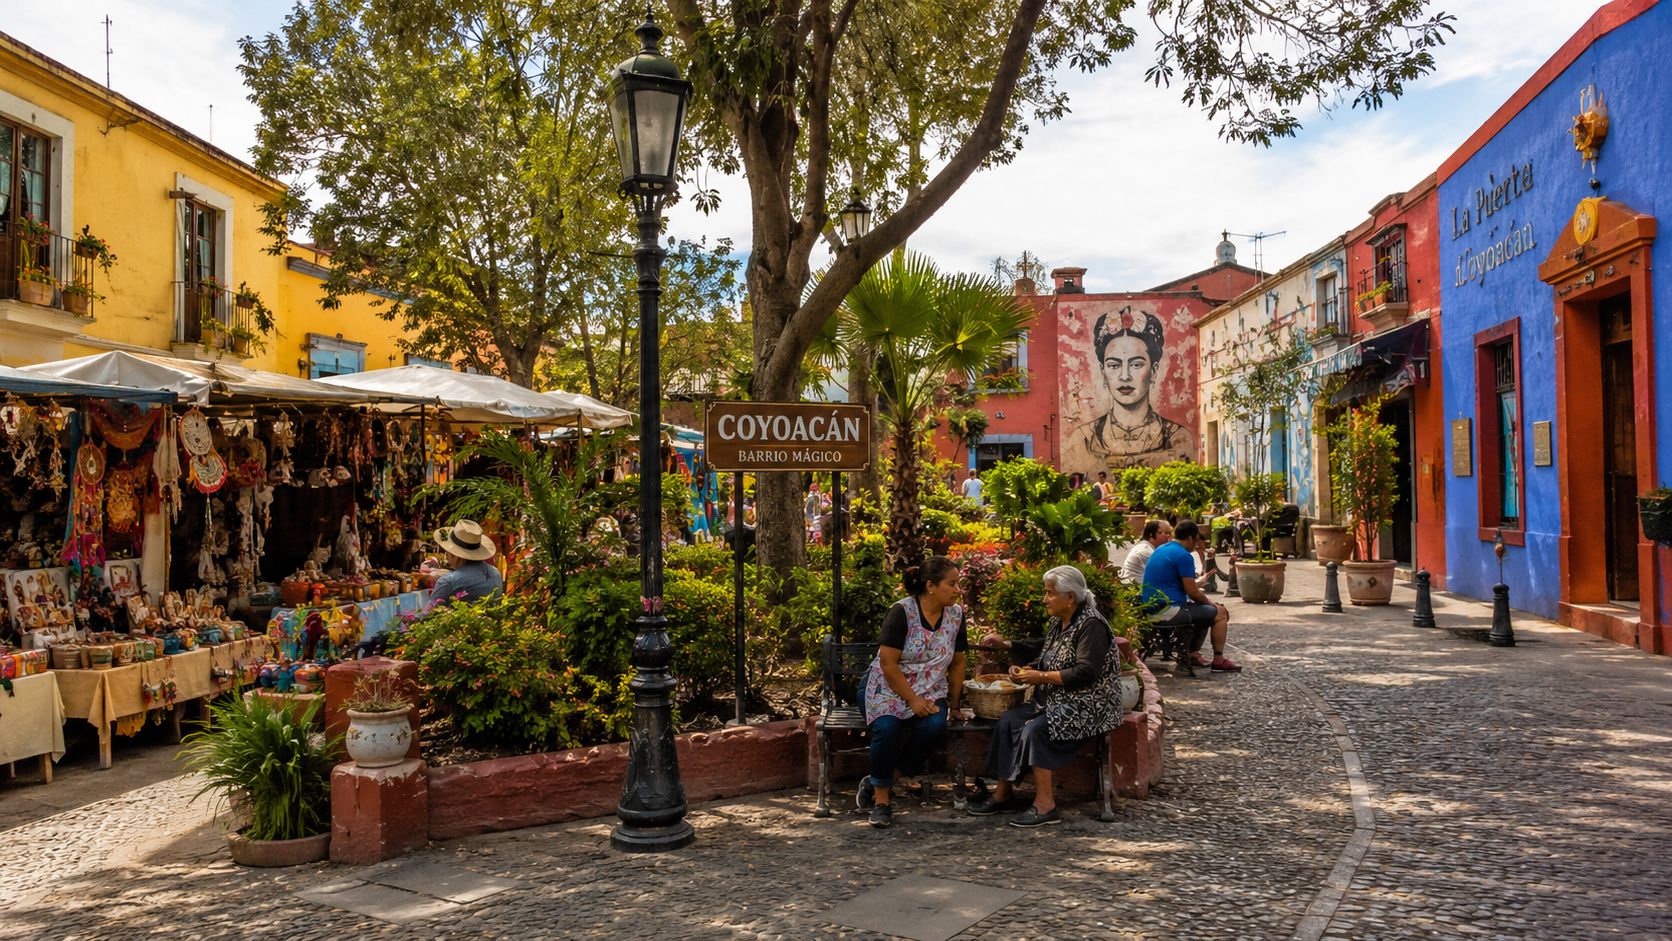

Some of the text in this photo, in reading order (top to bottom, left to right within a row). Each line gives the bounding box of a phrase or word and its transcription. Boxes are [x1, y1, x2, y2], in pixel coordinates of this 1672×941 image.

[1451, 206, 1470, 241] La
[718, 409, 860, 442] COYOACÁN
[738, 448, 842, 463] BARRIO MÁGICO
